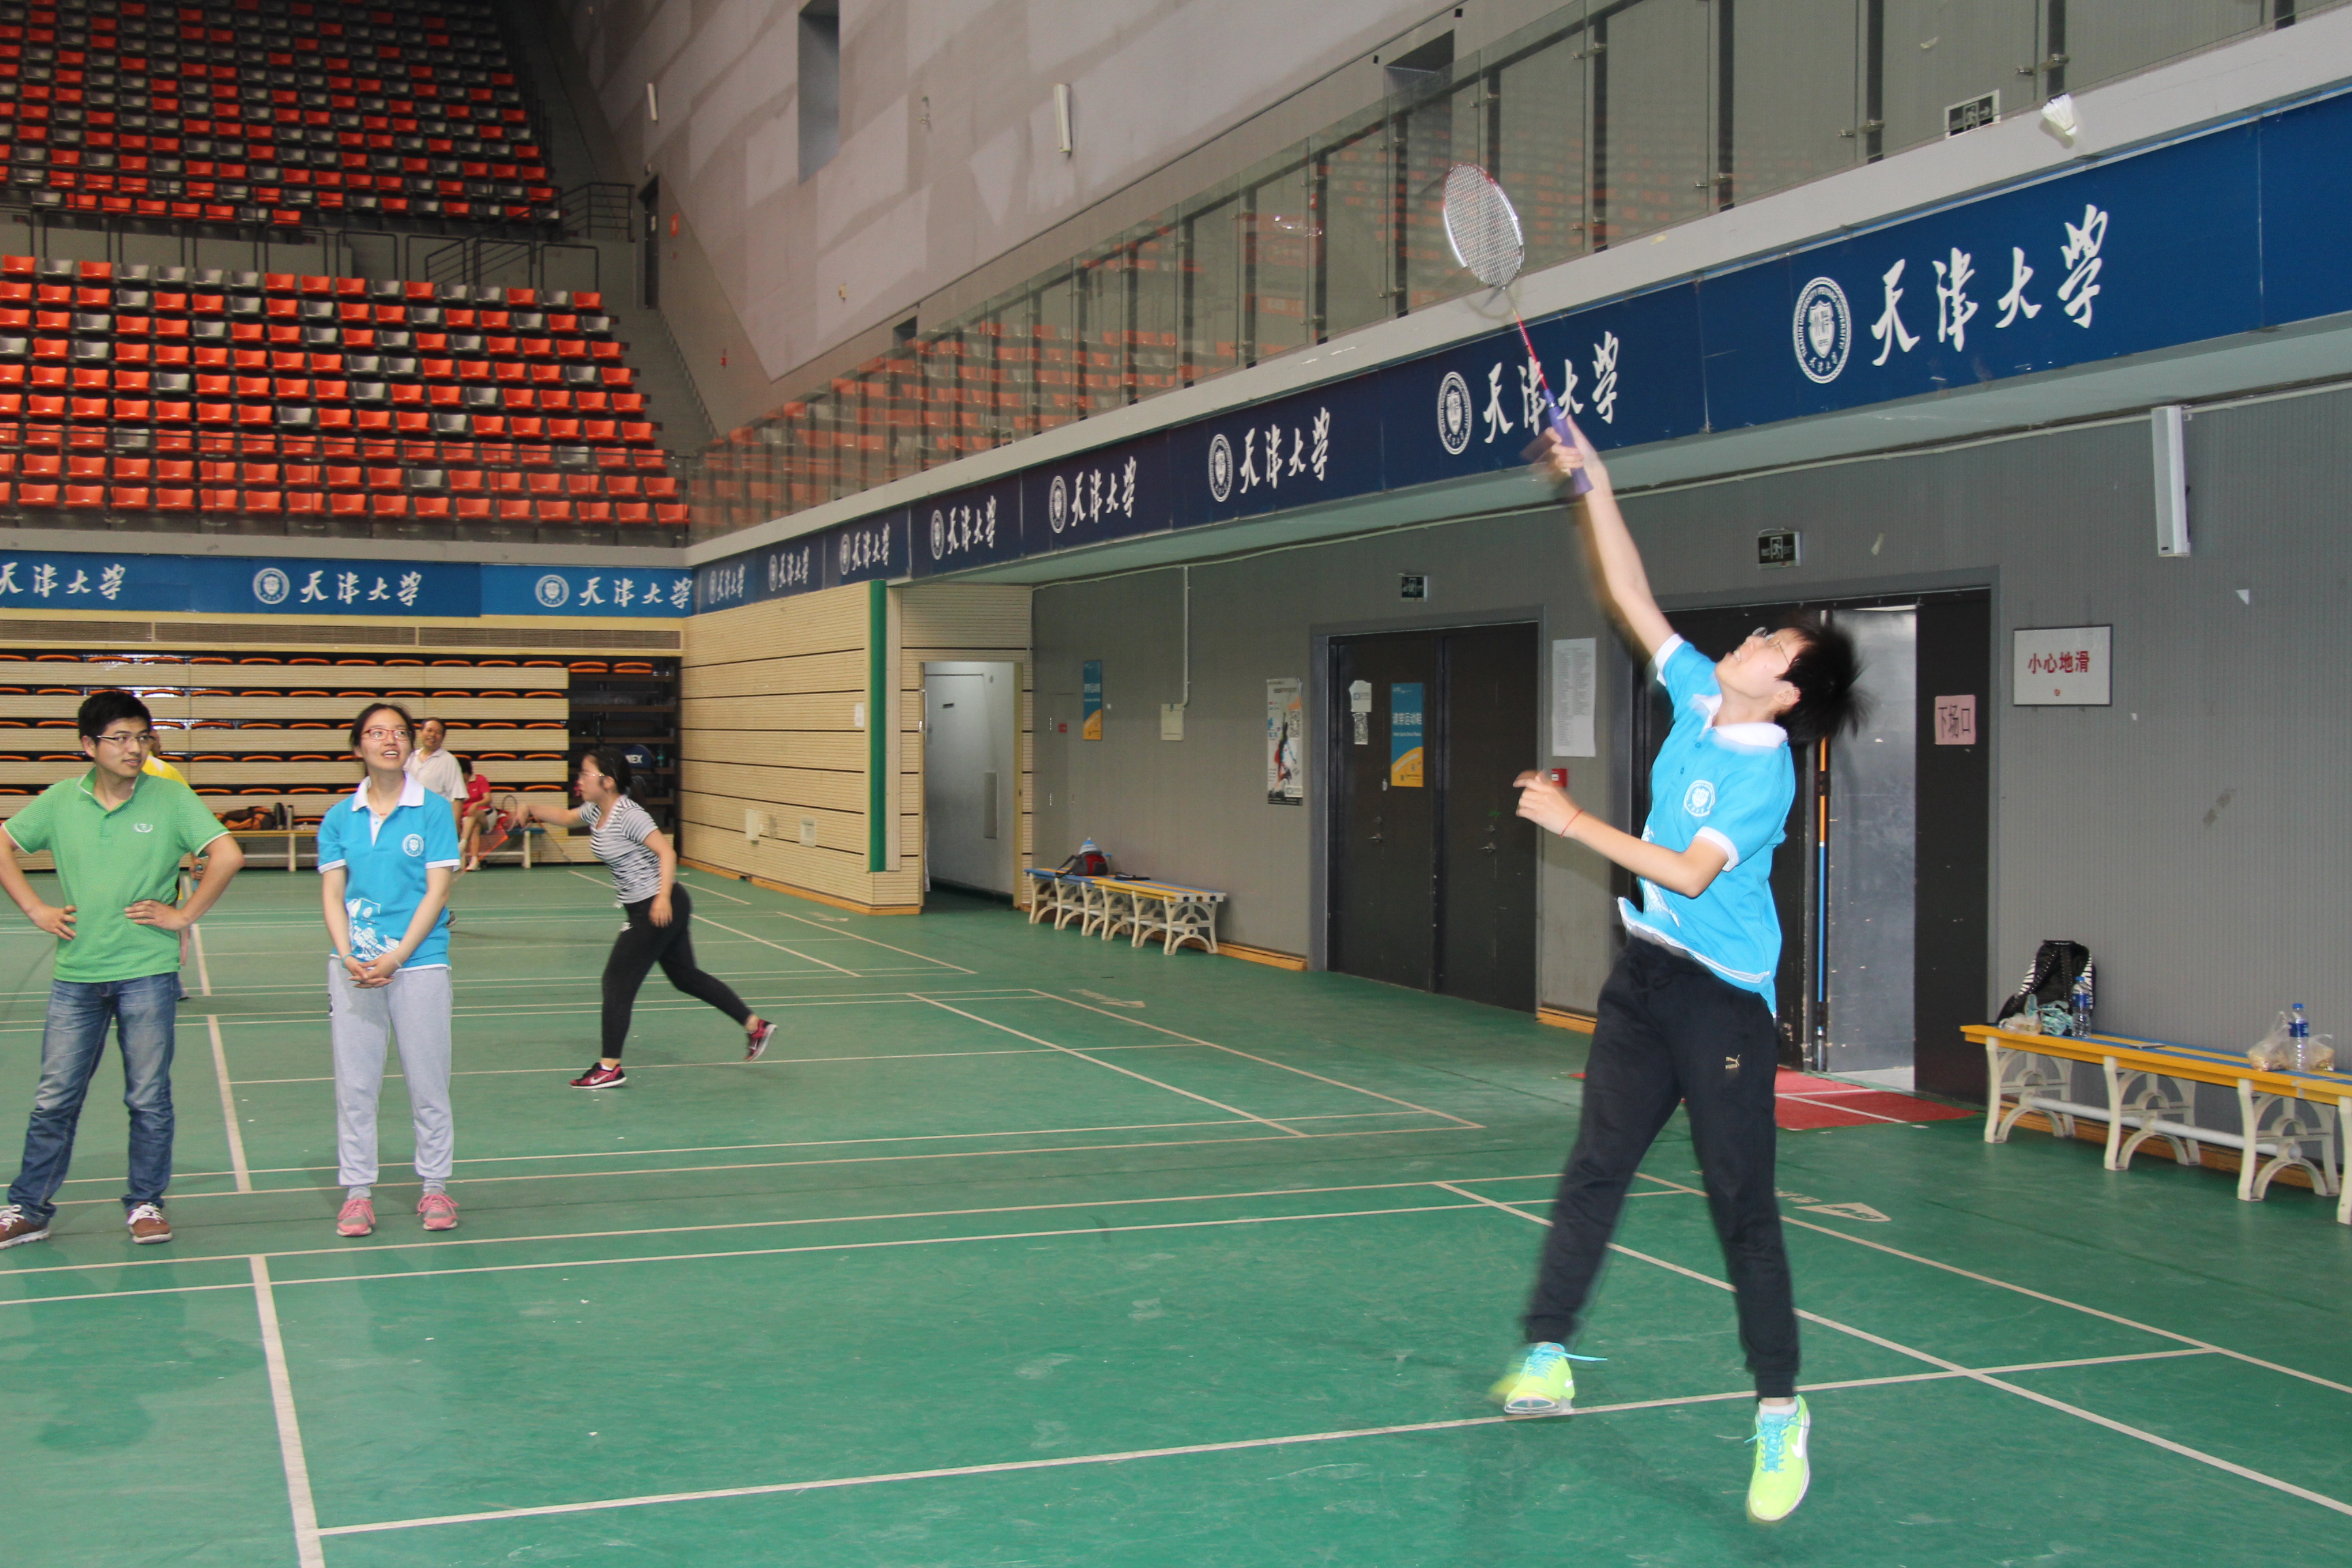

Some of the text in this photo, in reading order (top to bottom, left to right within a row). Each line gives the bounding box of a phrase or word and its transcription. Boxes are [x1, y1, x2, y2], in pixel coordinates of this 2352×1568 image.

[1871, 204, 2108, 366] 天津大学
[1483, 331, 1618, 443] 天津大学
[1239, 406, 1330, 493] 天津大学
[1071, 455, 1137, 527] 天津大学
[852, 522, 890, 570] 天津大学
[947, 495, 997, 555] 天津大学
[299, 570, 423, 607] 天津大学
[578, 576, 693, 610] 天津大学
[2027, 650, 2091, 674] 小心地滑
